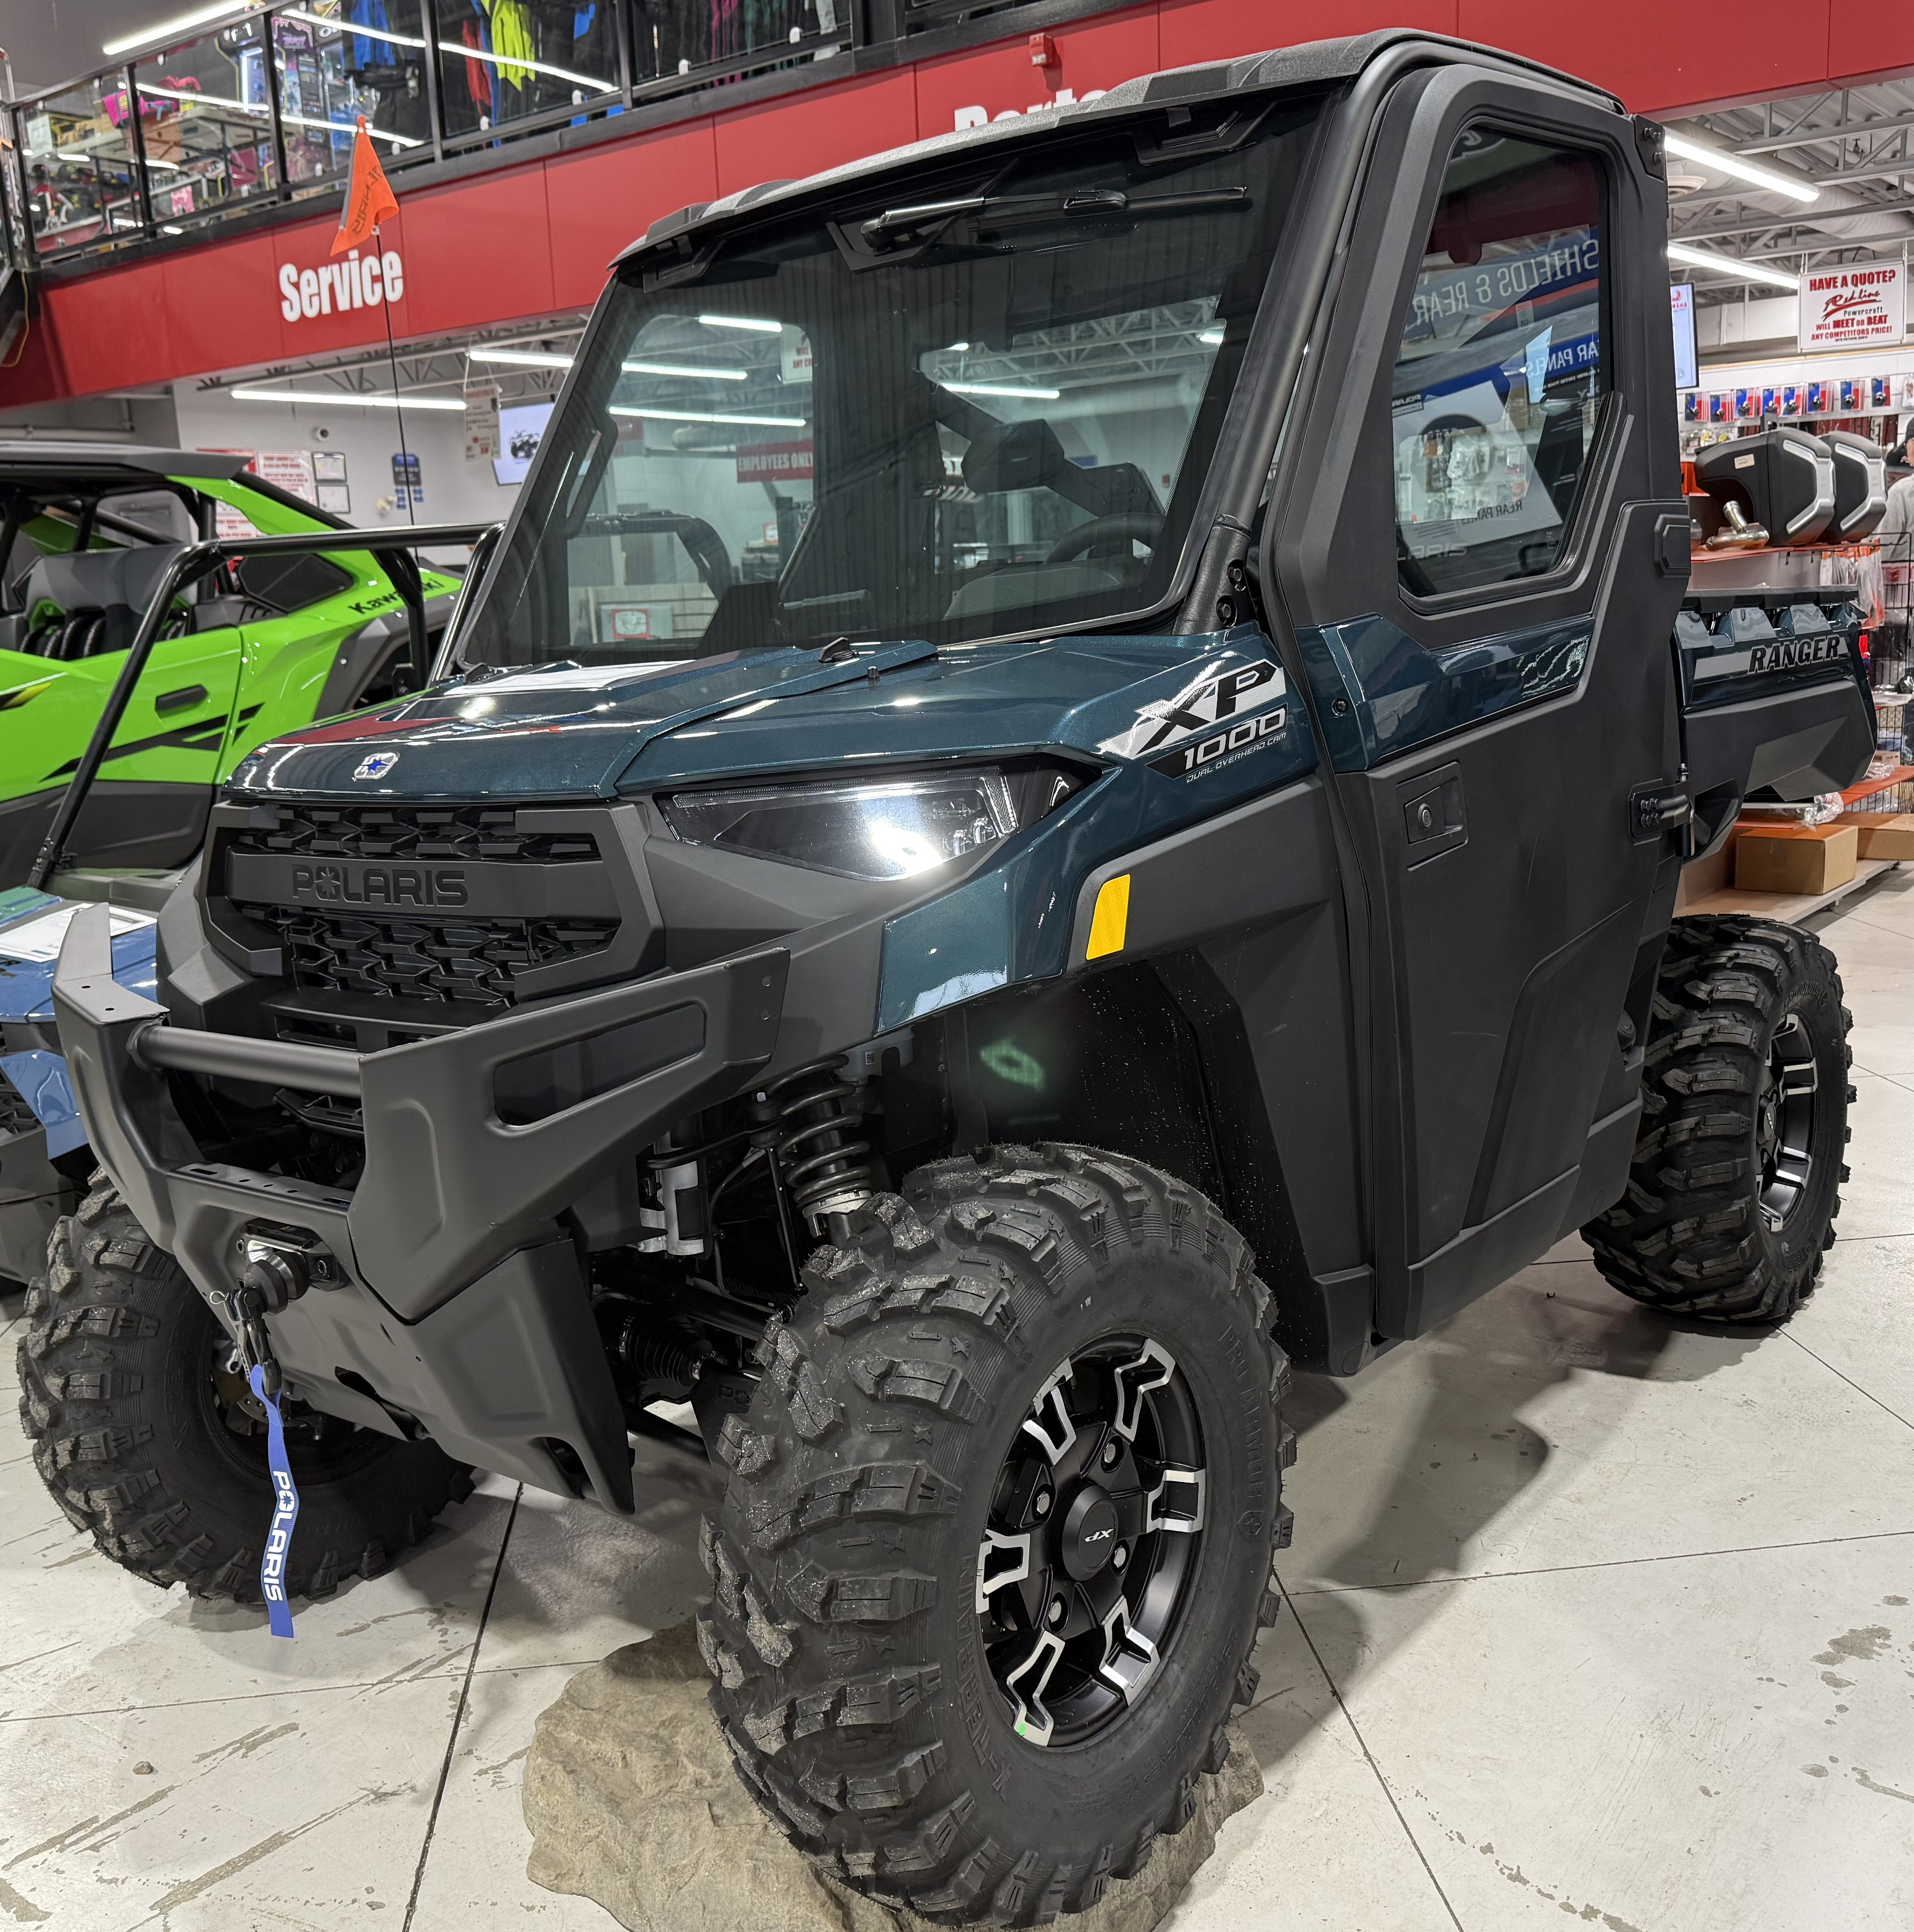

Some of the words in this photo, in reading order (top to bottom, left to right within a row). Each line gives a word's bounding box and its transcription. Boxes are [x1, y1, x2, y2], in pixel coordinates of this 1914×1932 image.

[279, 249, 403, 322] Service
[1809, 276, 1838, 292] HAVE
[1840, 275, 1848, 288] A
[1851, 269, 1896, 287] QUOTE?
[1816, 322, 1831, 331] WILL
[1833, 318, 1855, 329] MEET
[1867, 314, 1888, 325] BEAT
[1844, 306, 1883, 317] Powercraft
[1811, 333, 1823, 341] ANY
[1825, 328, 1870, 339] COMPETITORS
[1871, 326, 1892, 335] PRICE!
[738, 453, 790, 472] EMPLOYEES
[348, 577, 445, 615] Kawki
[1747, 634, 1840, 675] RANGER
[1135, 660, 1278, 756] XP
[1184, 708, 1286, 770] 1000
[1186, 765, 1214, 784] DUAL
[1215, 742, 1266, 770] OVERHEAD
[1267, 731, 1287, 748] CAM
[292, 863, 469, 909] POLARIS
[1238, 1386, 1268, 1499] ARMOR
[263, 1470, 296, 1602] POLARIS
[1084, 1527, 1114, 1543] XP
